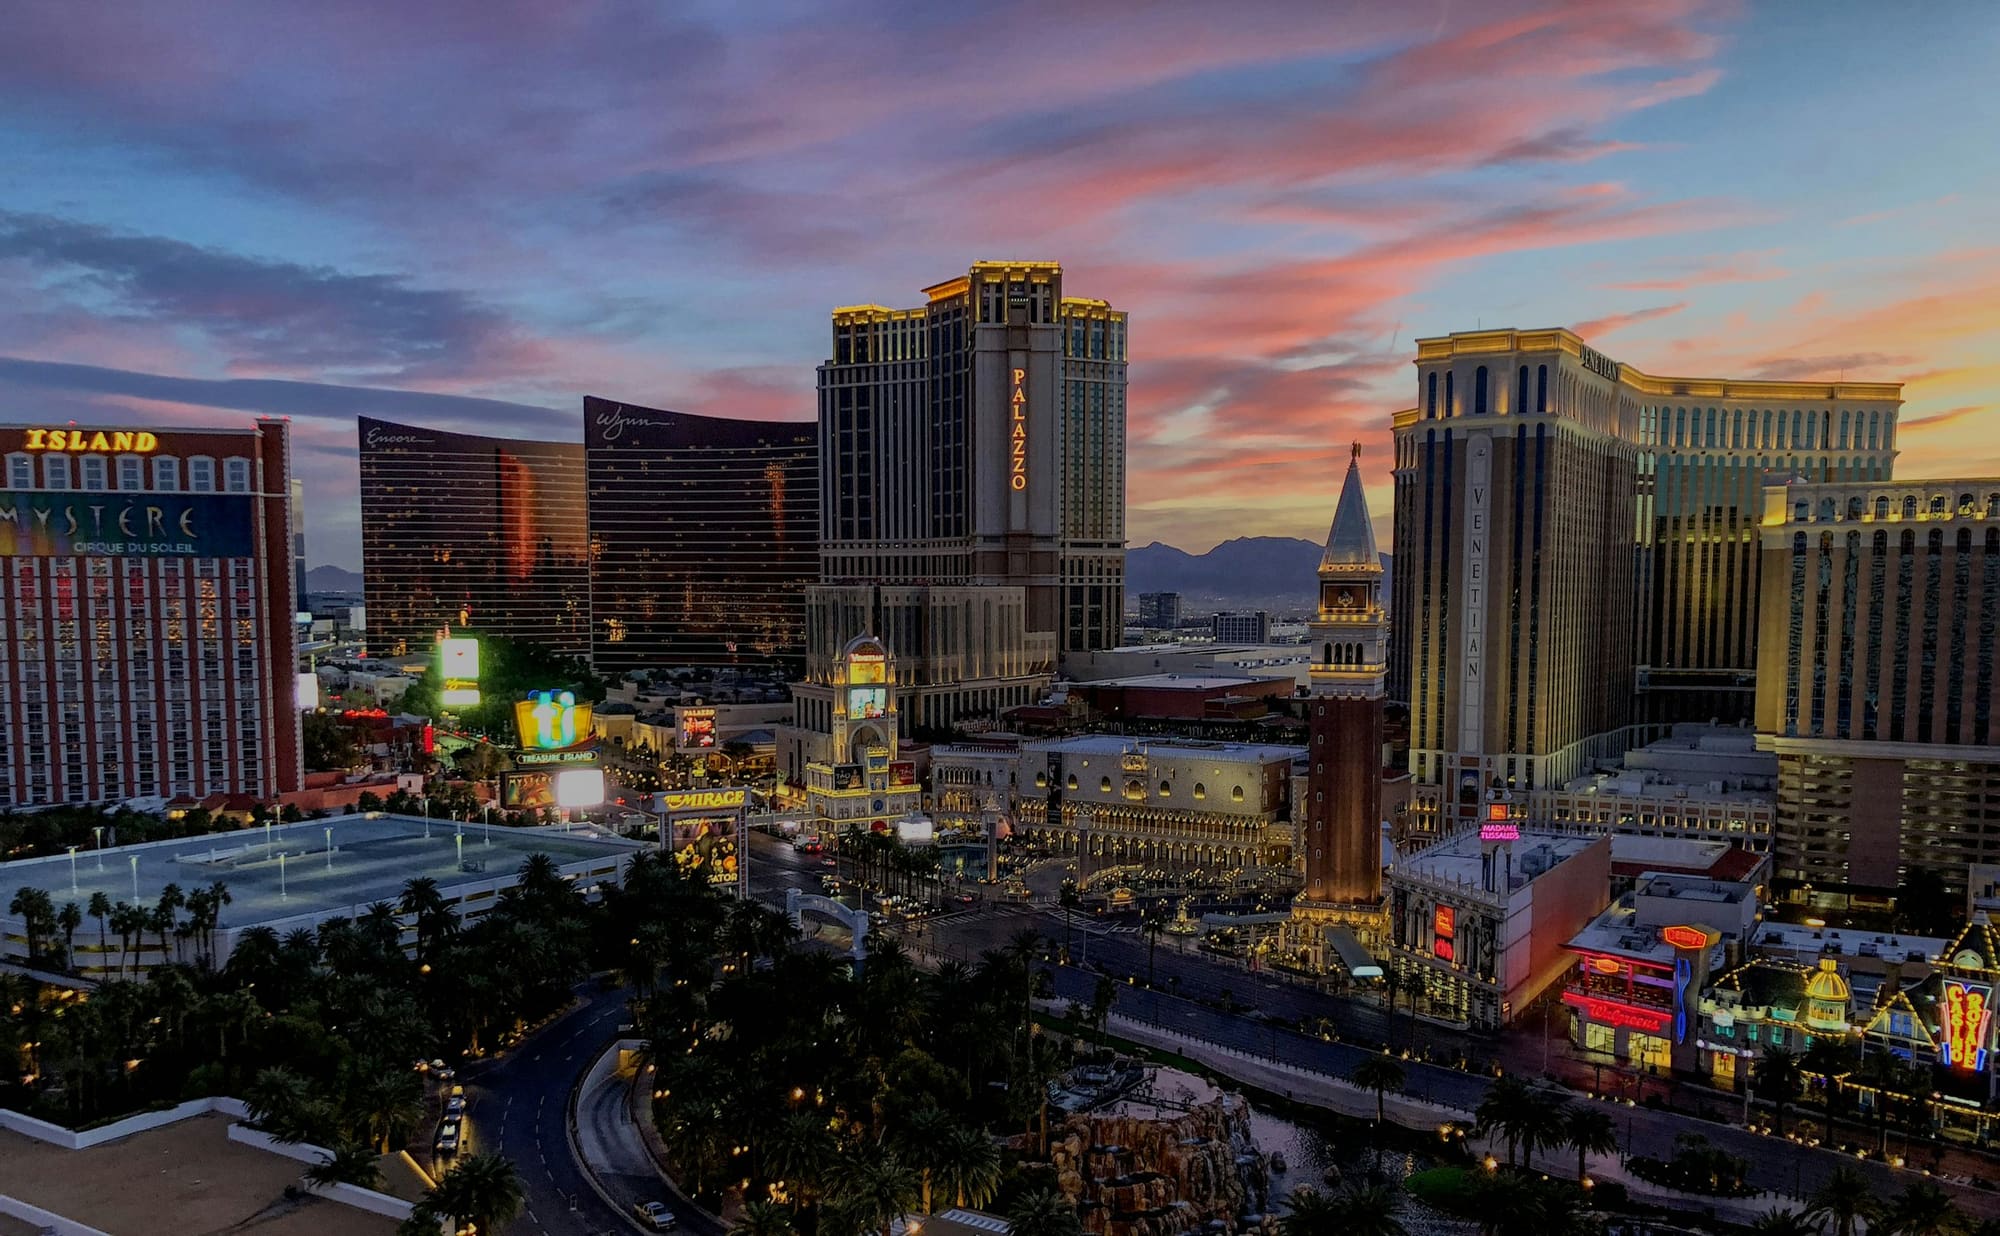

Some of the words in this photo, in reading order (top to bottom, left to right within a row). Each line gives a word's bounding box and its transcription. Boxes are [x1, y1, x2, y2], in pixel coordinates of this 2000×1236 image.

[1580, 343, 1618, 382] VENETIAN
[366, 427, 435, 444] Encore
[597, 406, 675, 440] Wynn
[1012, 368, 1026, 490] PALAZZO
[26, 429, 158, 452] ISLAND
[74, 541, 125, 556] CIRQUE
[127, 542, 147, 553] DU
[150, 541, 196, 554] SOLEIL
[1467, 487, 1484, 677] VENETIAN
[522, 753, 560, 763] TREASURE
[563, 751, 593, 761] ISLAND
[676, 790, 745, 809] MIRAGE
[1482, 824, 1518, 832] MADAME
[1589, 1003, 1660, 1031] Walgreens
[1948, 985, 1964, 1063] CASINO
[1963, 992, 1984, 1069] ROYALE
